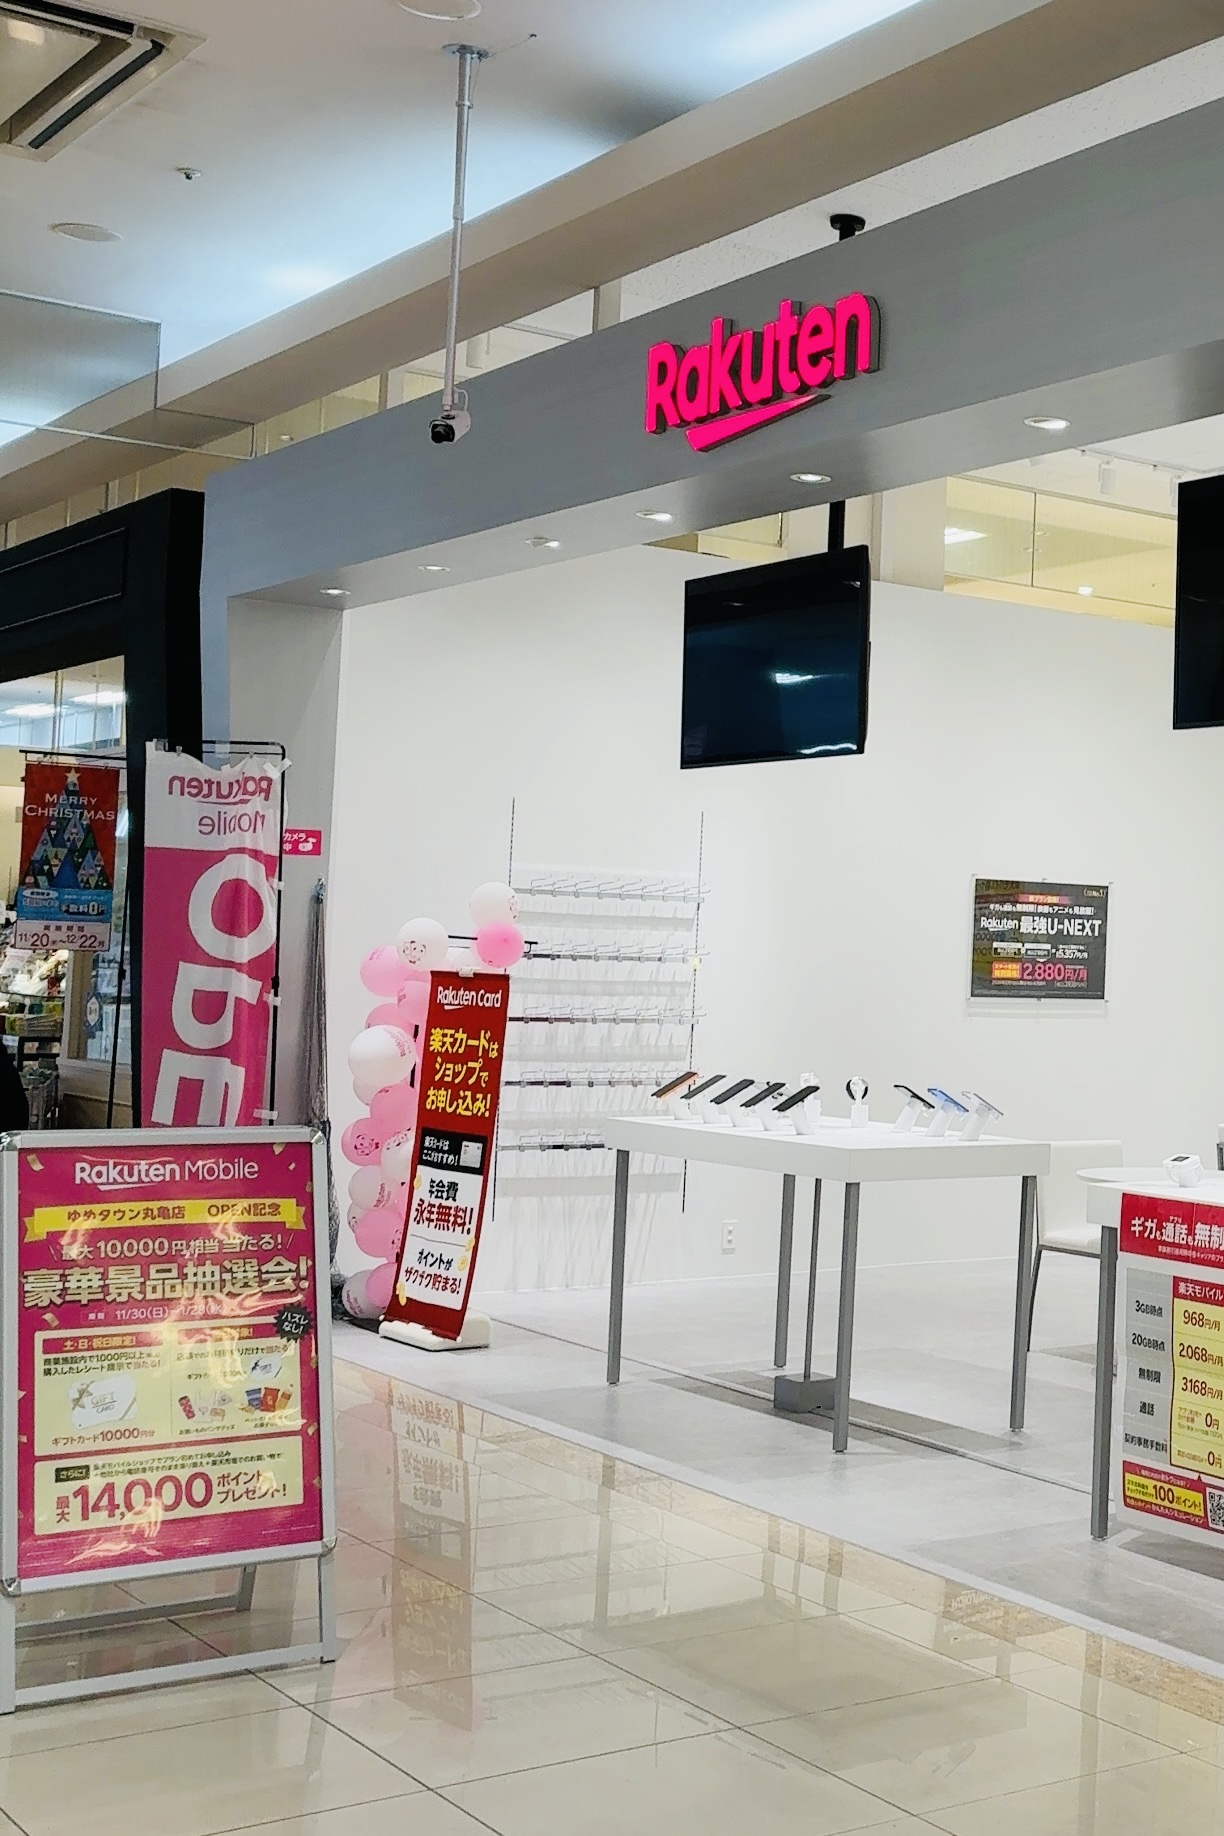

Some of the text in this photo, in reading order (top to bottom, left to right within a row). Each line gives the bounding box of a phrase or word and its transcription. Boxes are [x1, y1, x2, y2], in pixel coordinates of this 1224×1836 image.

[646, 293, 880, 434] Rakuten
[45, 793, 98, 806] MERRY
[25, 804, 115, 821] CHRISTMAS
[980, 916, 1102, 936] Rakuten 最強U-NEXT
[437, 985, 502, 1008] Rakuten Card
[429, 1027, 499, 1059] 楽天カードは
[434, 1056, 489, 1087] ショップで
[425, 1087, 491, 1118] お申し込み!
[75, 1158, 259, 1185] Rakuten Mobile
[67, 1202, 281, 1222] ゆめタウン丸亀店 OPEN記念
[413, 1197, 474, 1235] 永年無料!
[417, 1248, 454, 1271] ポイントが
[22, 1256, 310, 1308] 豪華景品抽選会!
[1178, 1282, 1224, 1301] 楽天モバイル
[281, 1311, 309, 1325] ハズレ
[1135, 1300, 1164, 1318] 3GB時点
[1182, 1309, 1221, 1332] 968円/月
[1131, 1332, 1166, 1352] 20GB時点
[1204, 1412, 1220, 1430] 0円
[1207, 1450, 1222, 1469] 0円
[216, 1469, 263, 1487] ポイント
[216, 1484, 287, 1504] プレゼント!
